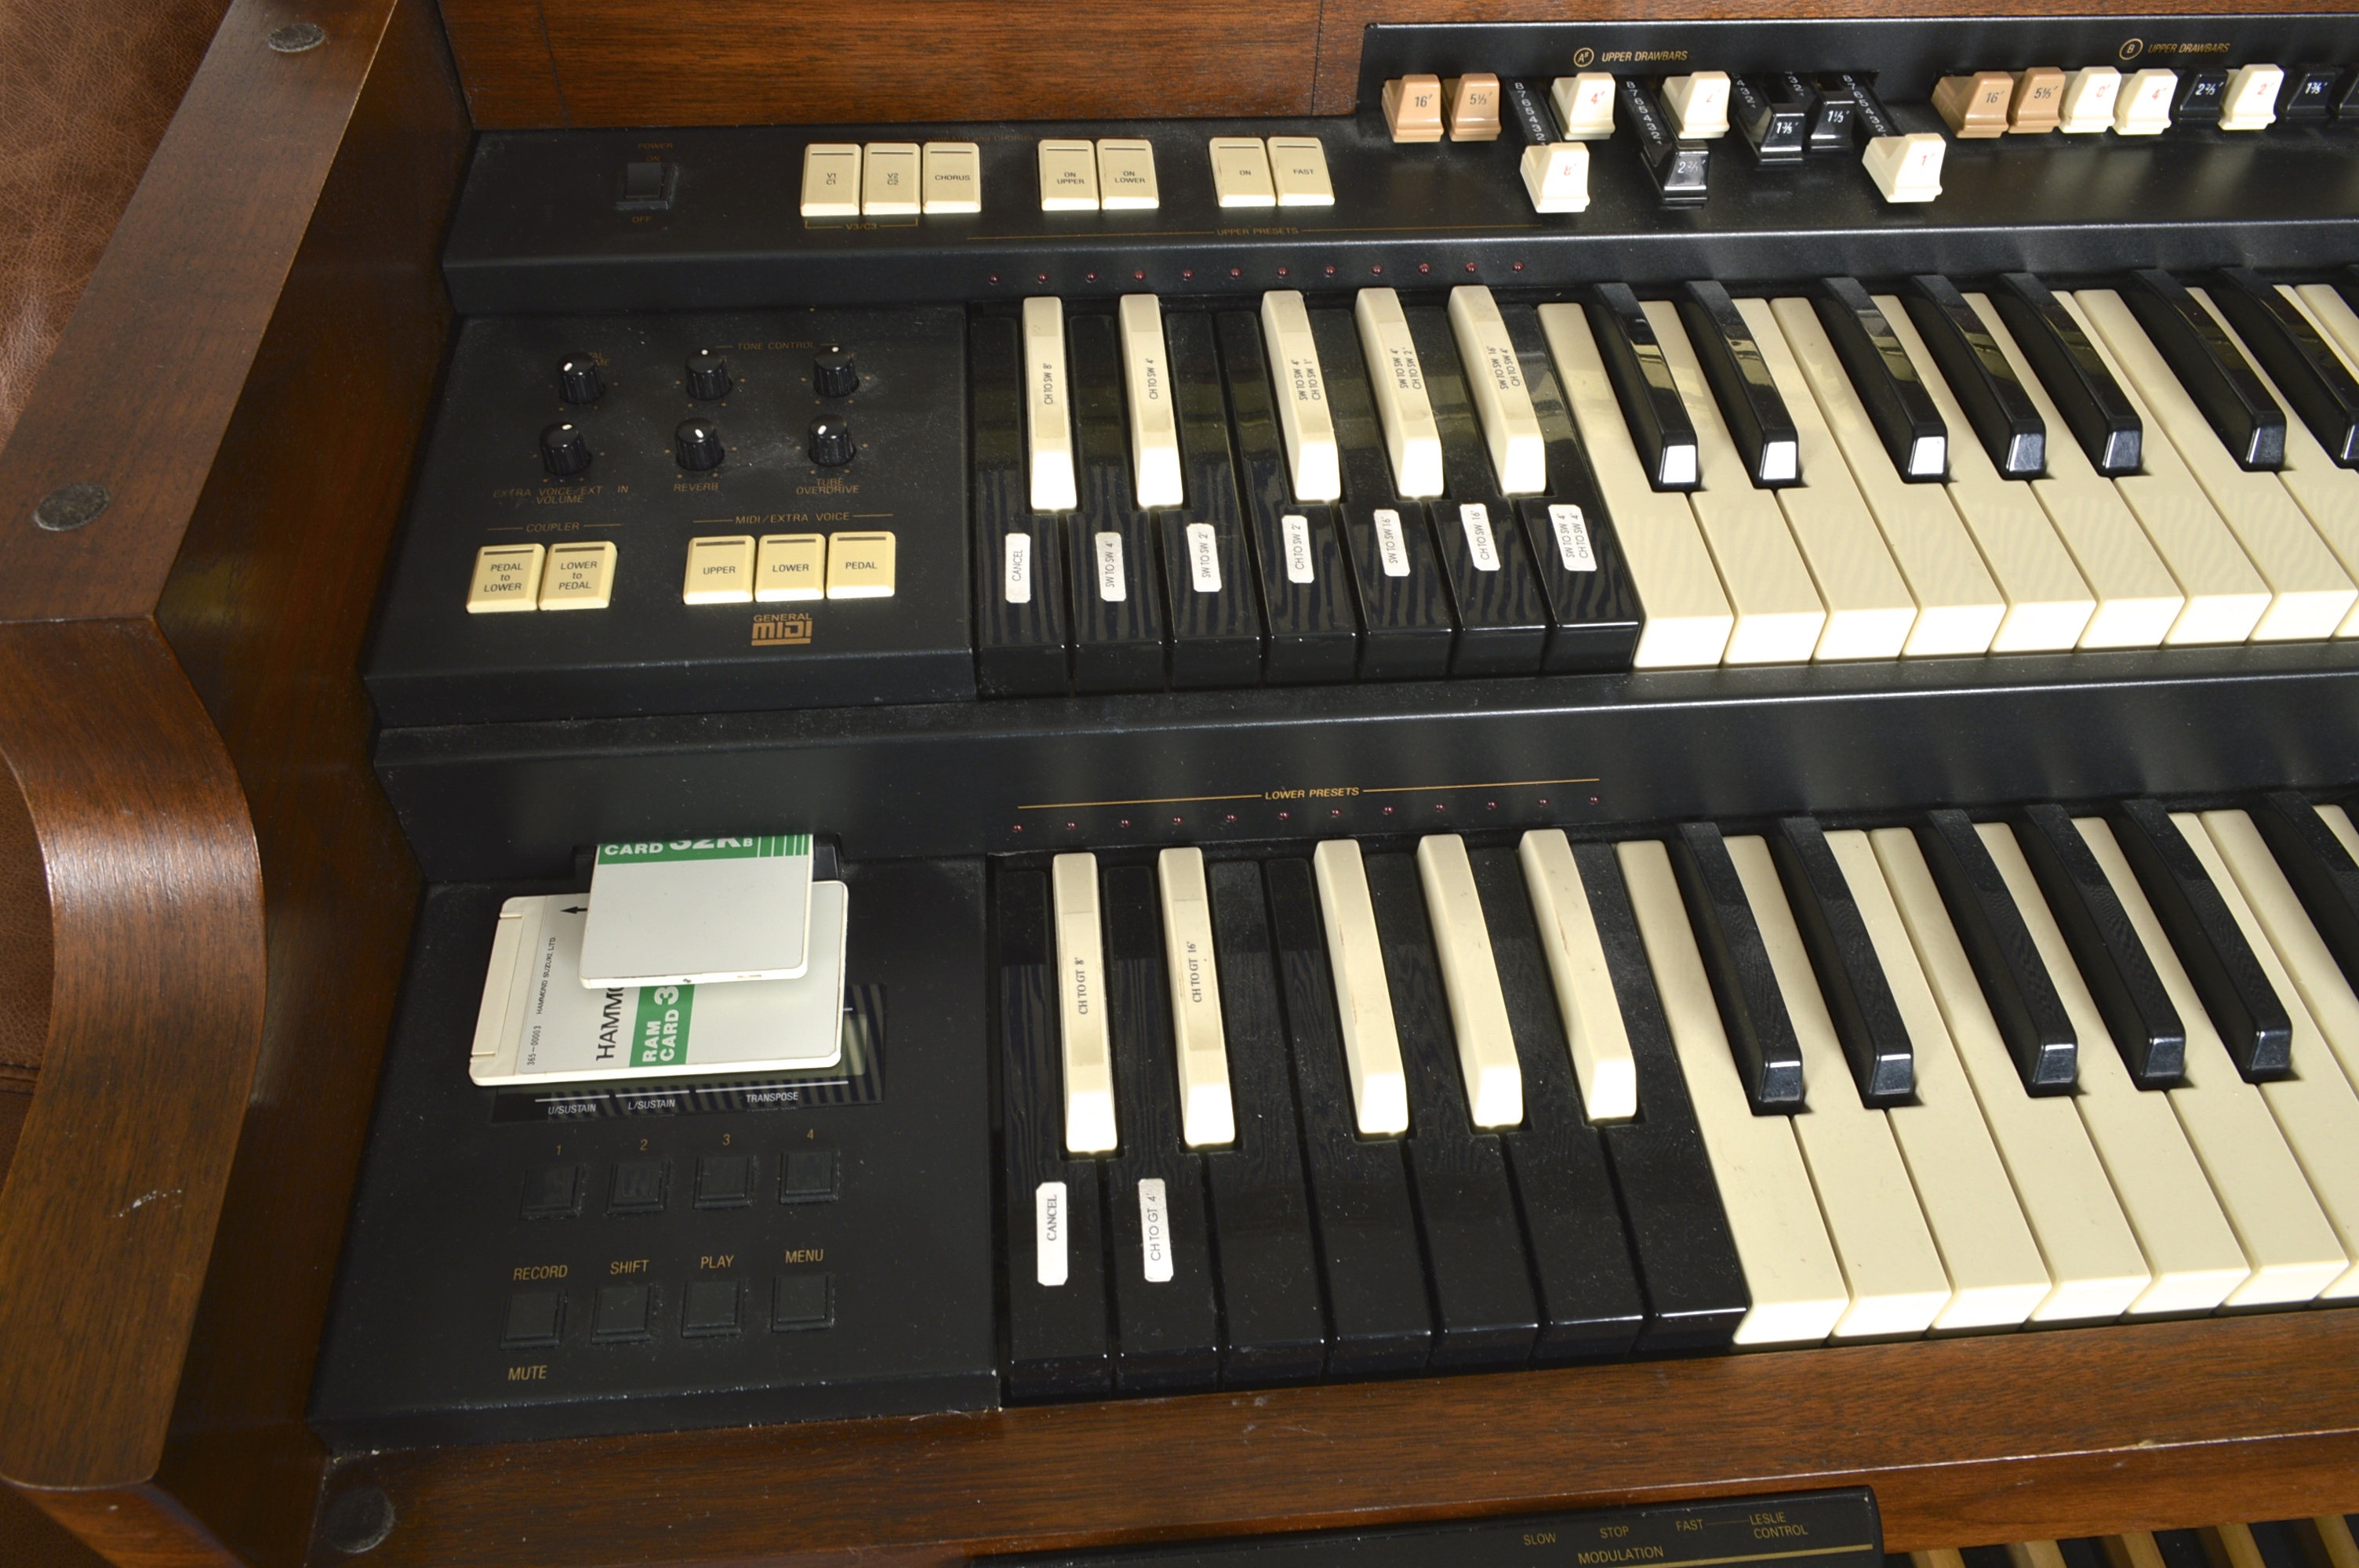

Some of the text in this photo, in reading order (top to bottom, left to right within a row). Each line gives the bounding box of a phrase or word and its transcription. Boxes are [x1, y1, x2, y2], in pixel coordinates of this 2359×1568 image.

[2148, 44, 2230, 53] UPPER DRAWBARS
[1601, 50, 1688, 62] UPPER DRAWBARS
[632, 216, 652, 224] OFF
[768, 341, 815, 350] CONTROL
[1405, 358, 1416, 368] SW
[1147, 367, 1156, 377] SW
[1392, 358, 1409, 389] SW TO SW
[1408, 368, 1418, 378] TO
[1491, 358, 1509, 390] SW TO SW
[1502, 354, 1521, 387] CH TO SW
[1043, 372, 1052, 383] SW
[1147, 378, 1157, 387] TO
[1044, 383, 1052, 393] TO
[1293, 368, 1308, 401] SW TO SW
[1306, 368, 1321, 401] CH TO SW
[1412, 379, 1422, 390] CH
[1044, 394, 1053, 405] CH
[1149, 389, 1158, 400] CH
[674, 481, 719, 492] REVERB
[816, 477, 845, 486] TUBE
[493, 488, 532, 499] EXTRA
[617, 485, 630, 494] IN
[796, 485, 860, 495] OVERDRIVE
[536, 495, 584, 505] VOLUME
[816, 512, 850, 521] VOICE
[526, 521, 580, 533] COUPLER
[1474, 524, 1485, 535] SW
[1558, 523, 1569, 535] SW
[1572, 523, 1583, 535] SW
[1292, 533, 1303, 545] SW
[1383, 528, 1394, 540] SW
[1386, 541, 1396, 552] TO
[1477, 536, 1487, 547] TO
[1561, 535, 1571, 546] TO
[1575, 535, 1585, 546] TO
[1199, 542, 1209, 554] SW
[1293, 546, 1303, 556] TO
[1565, 546, 1575, 558] SW
[1579, 546, 1589, 558] CH
[1104, 550, 1114, 563] SW
[1200, 554, 1210, 566] TO
[1388, 553, 1398, 564] SW
[1480, 548, 1490, 561] CH
[490, 563, 523, 572] PEDAL
[561, 561, 598, 570] LOWER
[772, 564, 809, 573] LOWER
[845, 561, 878, 570] PEDAL
[1012, 550, 1023, 582] CANCEL
[1105, 564, 1115, 575] TO
[1295, 557, 1305, 570] CH
[703, 565, 736, 575] UPPER
[1201, 567, 1212, 578] SW
[484, 583, 522, 593] LOWER
[558, 582, 592, 590] PEDAL
[1105, 577, 1115, 588] SW
[754, 613, 813, 622] GENERAL
[1265, 787, 1360, 800] LOWER PRESETS
[605, 843, 664, 855] CARD
[1188, 958, 1198, 971] GT
[1075, 969, 1085, 983] GT
[1190, 972, 1201, 987] TO
[536, 980, 548, 1015] HAMMOND
[1076, 984, 1087, 999] TO
[1191, 988, 1202, 1003] CH
[1078, 1000, 1089, 1014] CH
[642, 1021, 662, 1062] RAM
[660, 1009, 679, 1062] CARD
[746, 1092, 798, 1104] TRANSPOSE
[547, 1103, 597, 1115] U/SUSTAIN
[628, 1099, 675, 1111] L/SUSTAIN
[722, 1134, 731, 1146] 3
[806, 1128, 814, 1141] 4
[557, 1145, 562, 1156] 1
[639, 1138, 649, 1151] 2
[1046, 1194, 1057, 1241] CANCEL
[1147, 1208, 1158, 1223] GT
[1148, 1225, 1160, 1241] TO
[785, 1248, 823, 1264] MENU
[1150, 1243, 1161, 1261] CH
[610, 1259, 649, 1275] SHIFT
[701, 1254, 735, 1269] PLAY
[513, 1265, 569, 1281] RECORD
[507, 1365, 547, 1381] MUTE
[1675, 1514, 1787, 1532] FAST LESLIE
[1599, 1526, 1630, 1539] STOP
[1754, 1524, 1809, 1540] CONTROL
[1523, 1533, 1556, 1546] SLOW
[1577, 1546, 1664, 1565] MODULATION
